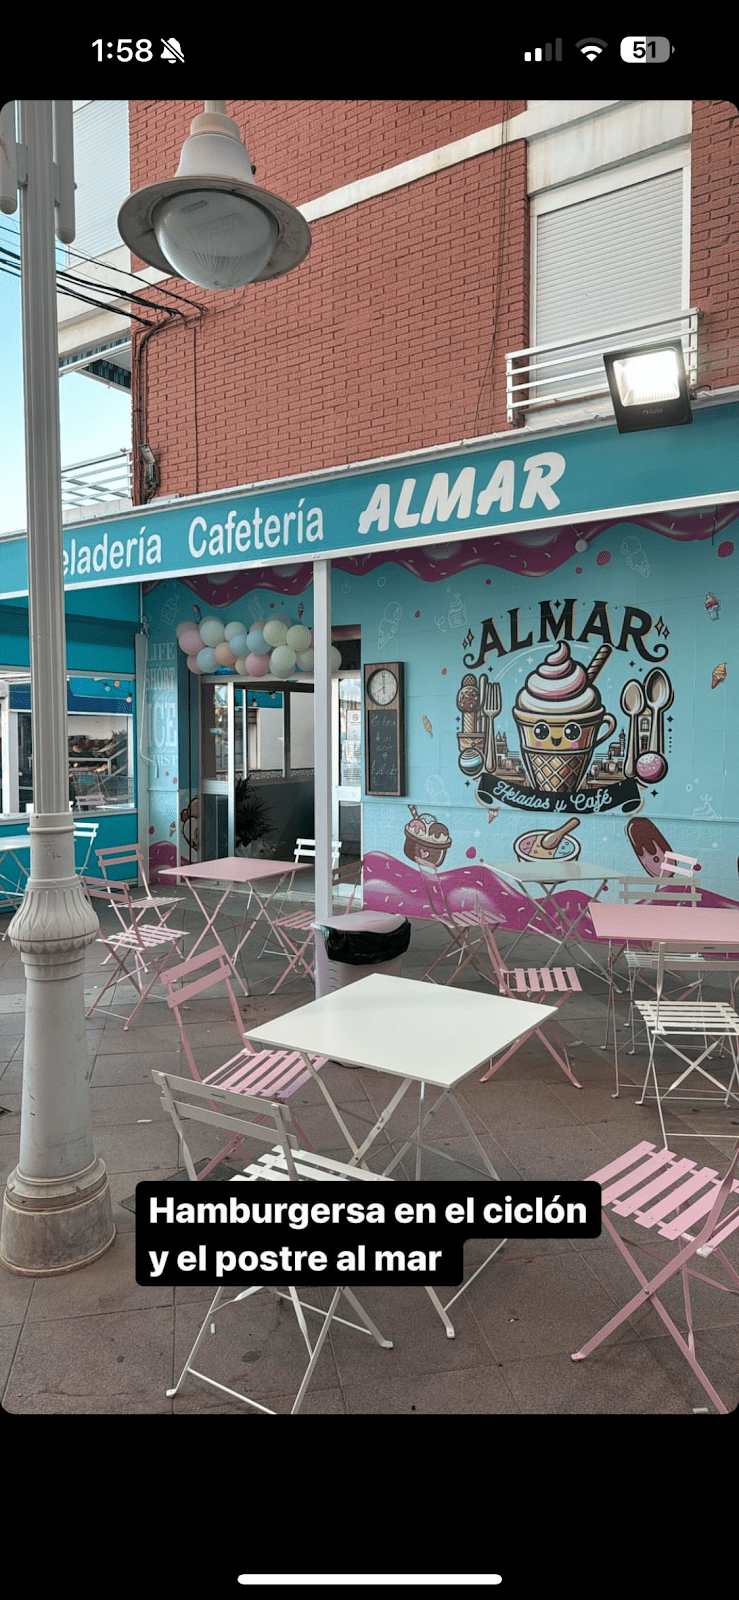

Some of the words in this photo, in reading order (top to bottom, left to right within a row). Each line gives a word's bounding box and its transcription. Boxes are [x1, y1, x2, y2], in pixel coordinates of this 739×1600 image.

[63, 525, 162, 575] ladería
[188, 498, 324, 559] Cafetería
[357, 451, 567, 535] ALMAR
[463, 598, 669, 670] ALMAR
[493, 780, 550, 810] Helados
[553, 799, 568, 813] y
[569, 788, 613, 813] Café
